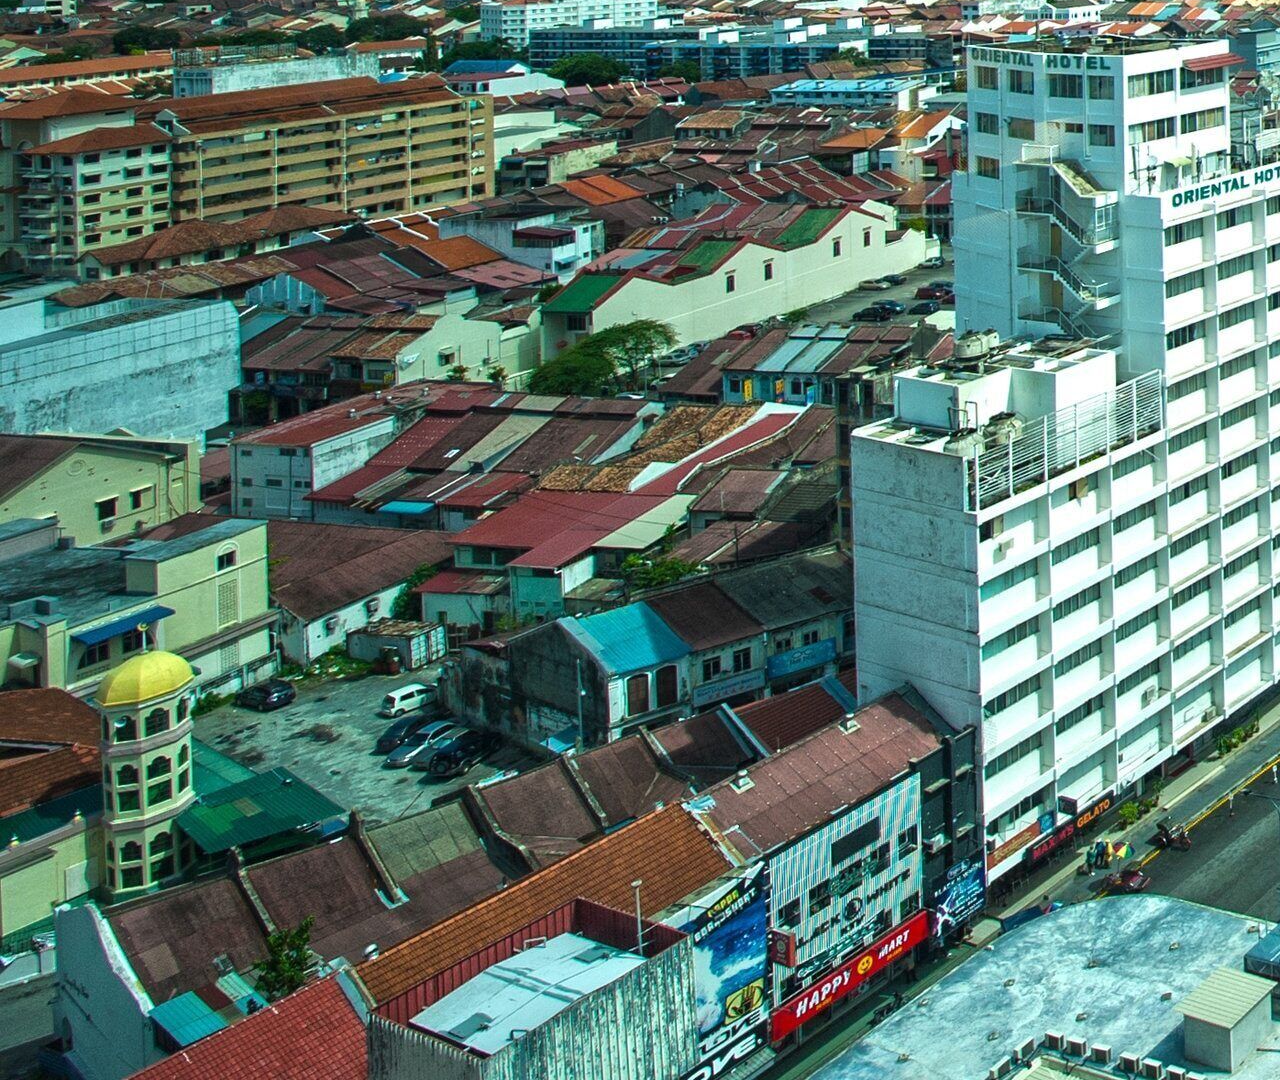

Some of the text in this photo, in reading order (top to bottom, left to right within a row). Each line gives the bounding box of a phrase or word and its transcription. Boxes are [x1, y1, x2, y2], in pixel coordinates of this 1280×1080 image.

[971, 47, 1111, 70] ORIENTAL HOTEL
[1172, 177, 1250, 208] ORIENTAL
[1077, 799, 1110, 828] GELATO
[796, 912, 841, 949] LACK
[795, 968, 852, 1018] HAPPY
[878, 929, 910, 960] MART
